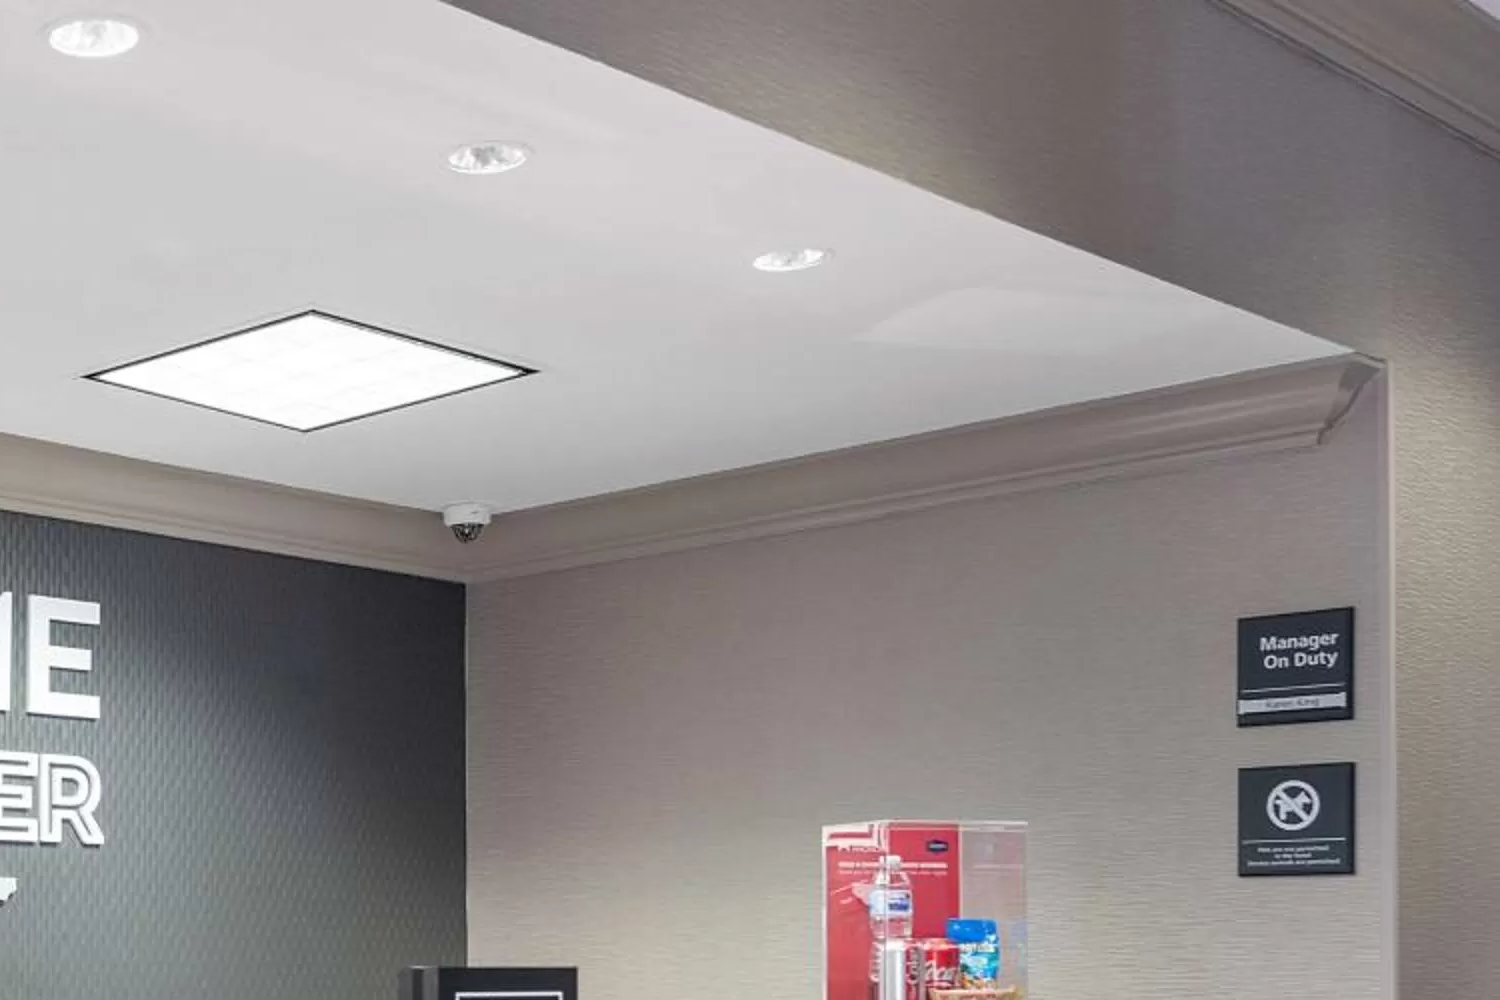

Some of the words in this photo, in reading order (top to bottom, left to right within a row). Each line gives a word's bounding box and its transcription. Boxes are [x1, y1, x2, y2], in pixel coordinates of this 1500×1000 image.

[1260, 633, 1340, 651] Manager
[1263, 654, 1289, 669] On
[1293, 651, 1339, 669] Duty
